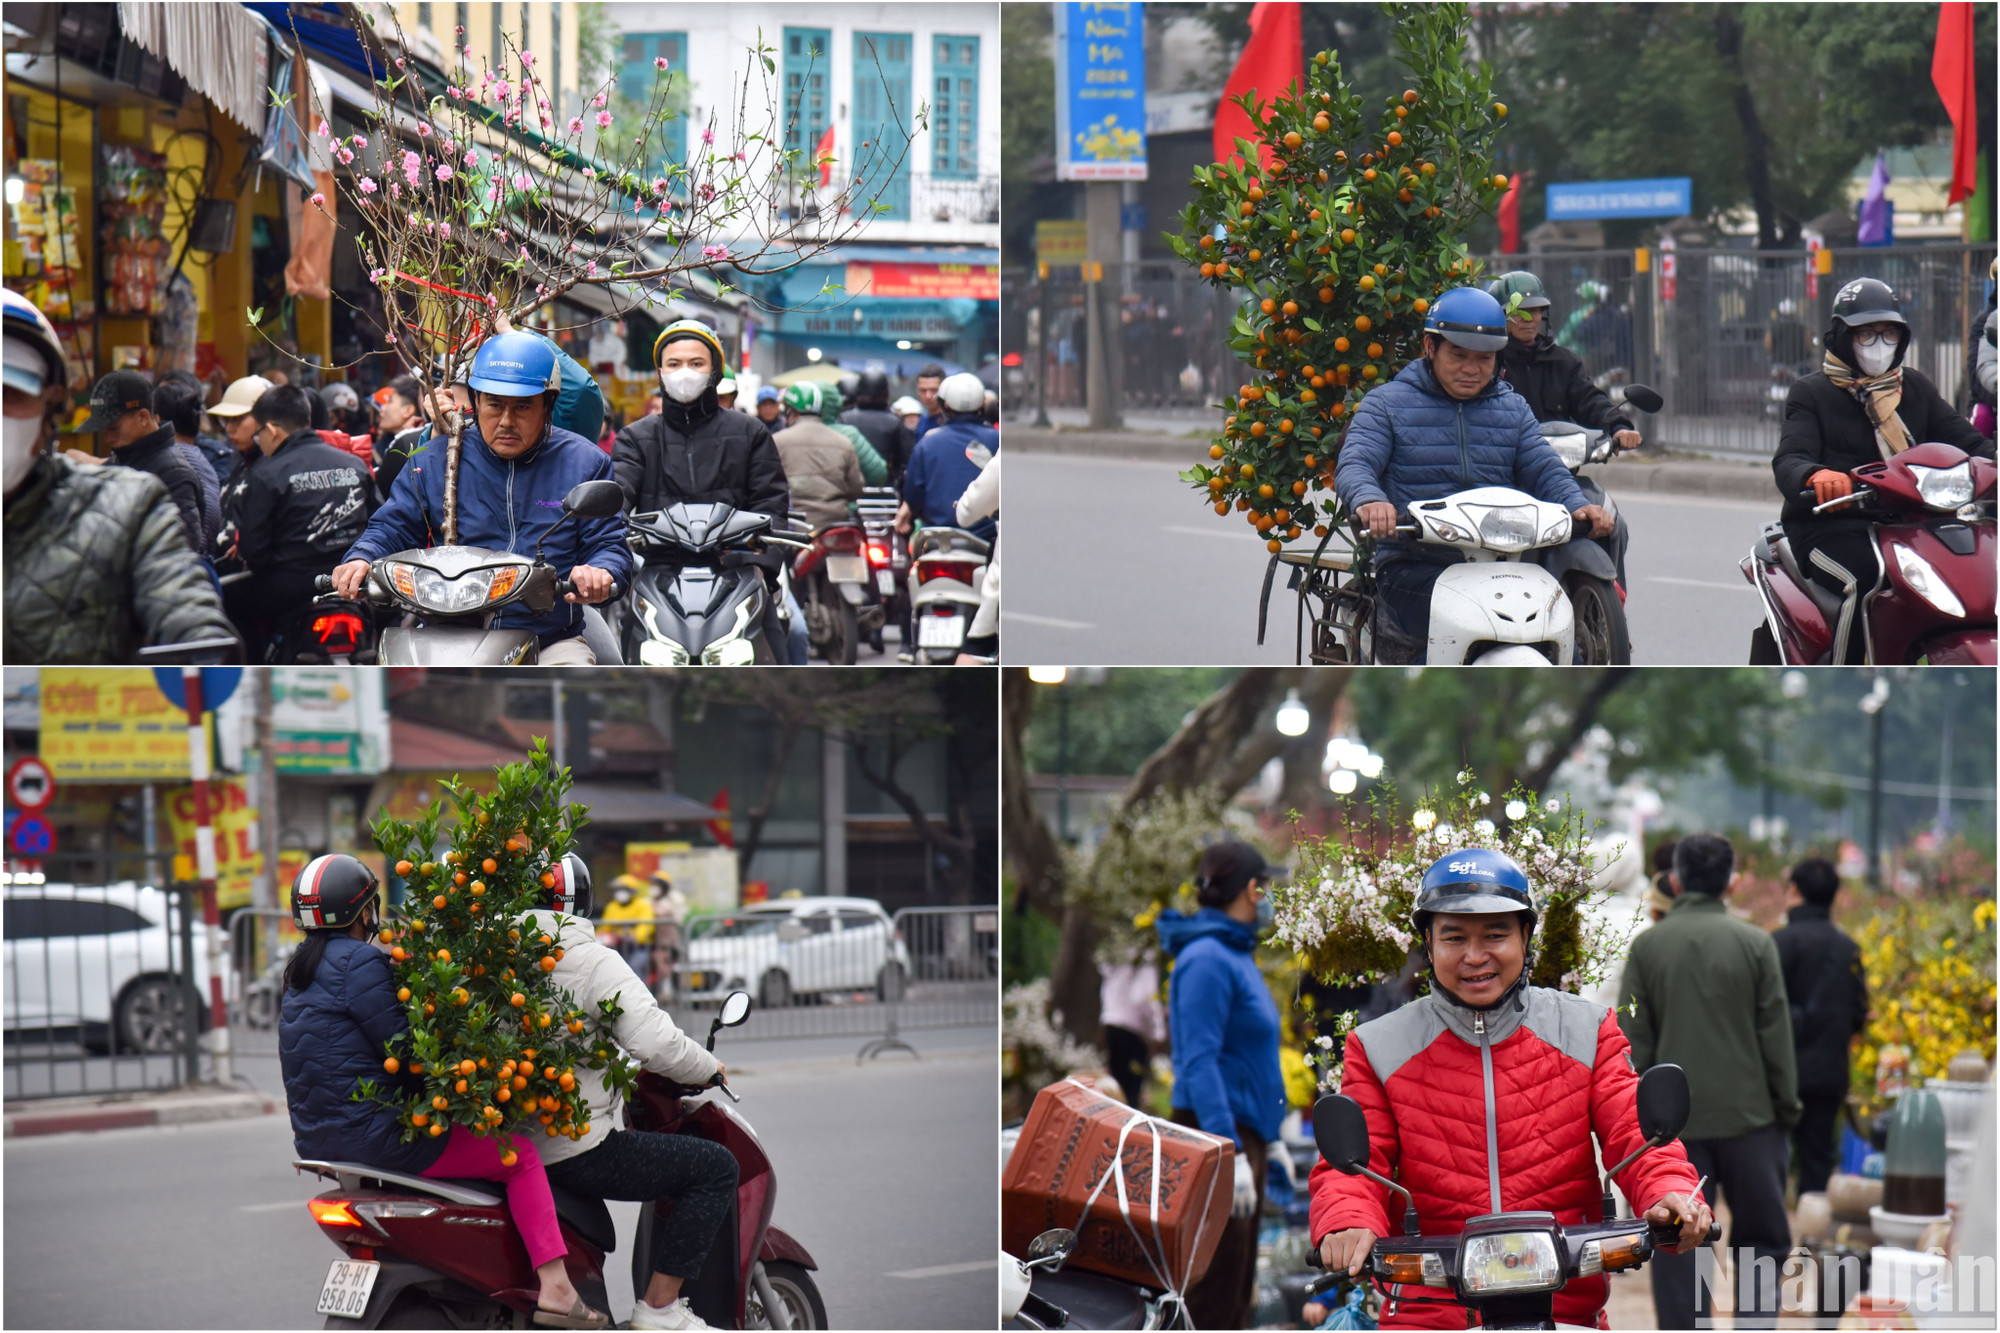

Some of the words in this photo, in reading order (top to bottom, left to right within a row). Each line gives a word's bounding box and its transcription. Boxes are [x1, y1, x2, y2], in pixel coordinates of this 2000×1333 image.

[489, 360, 524, 369] SKYWORTH
[289, 467, 360, 493] SKATERS
[297, 893, 322, 904] Owen
[331, 1263, 370, 1287] 29-H1
[320, 1288, 365, 1313] 958.06
